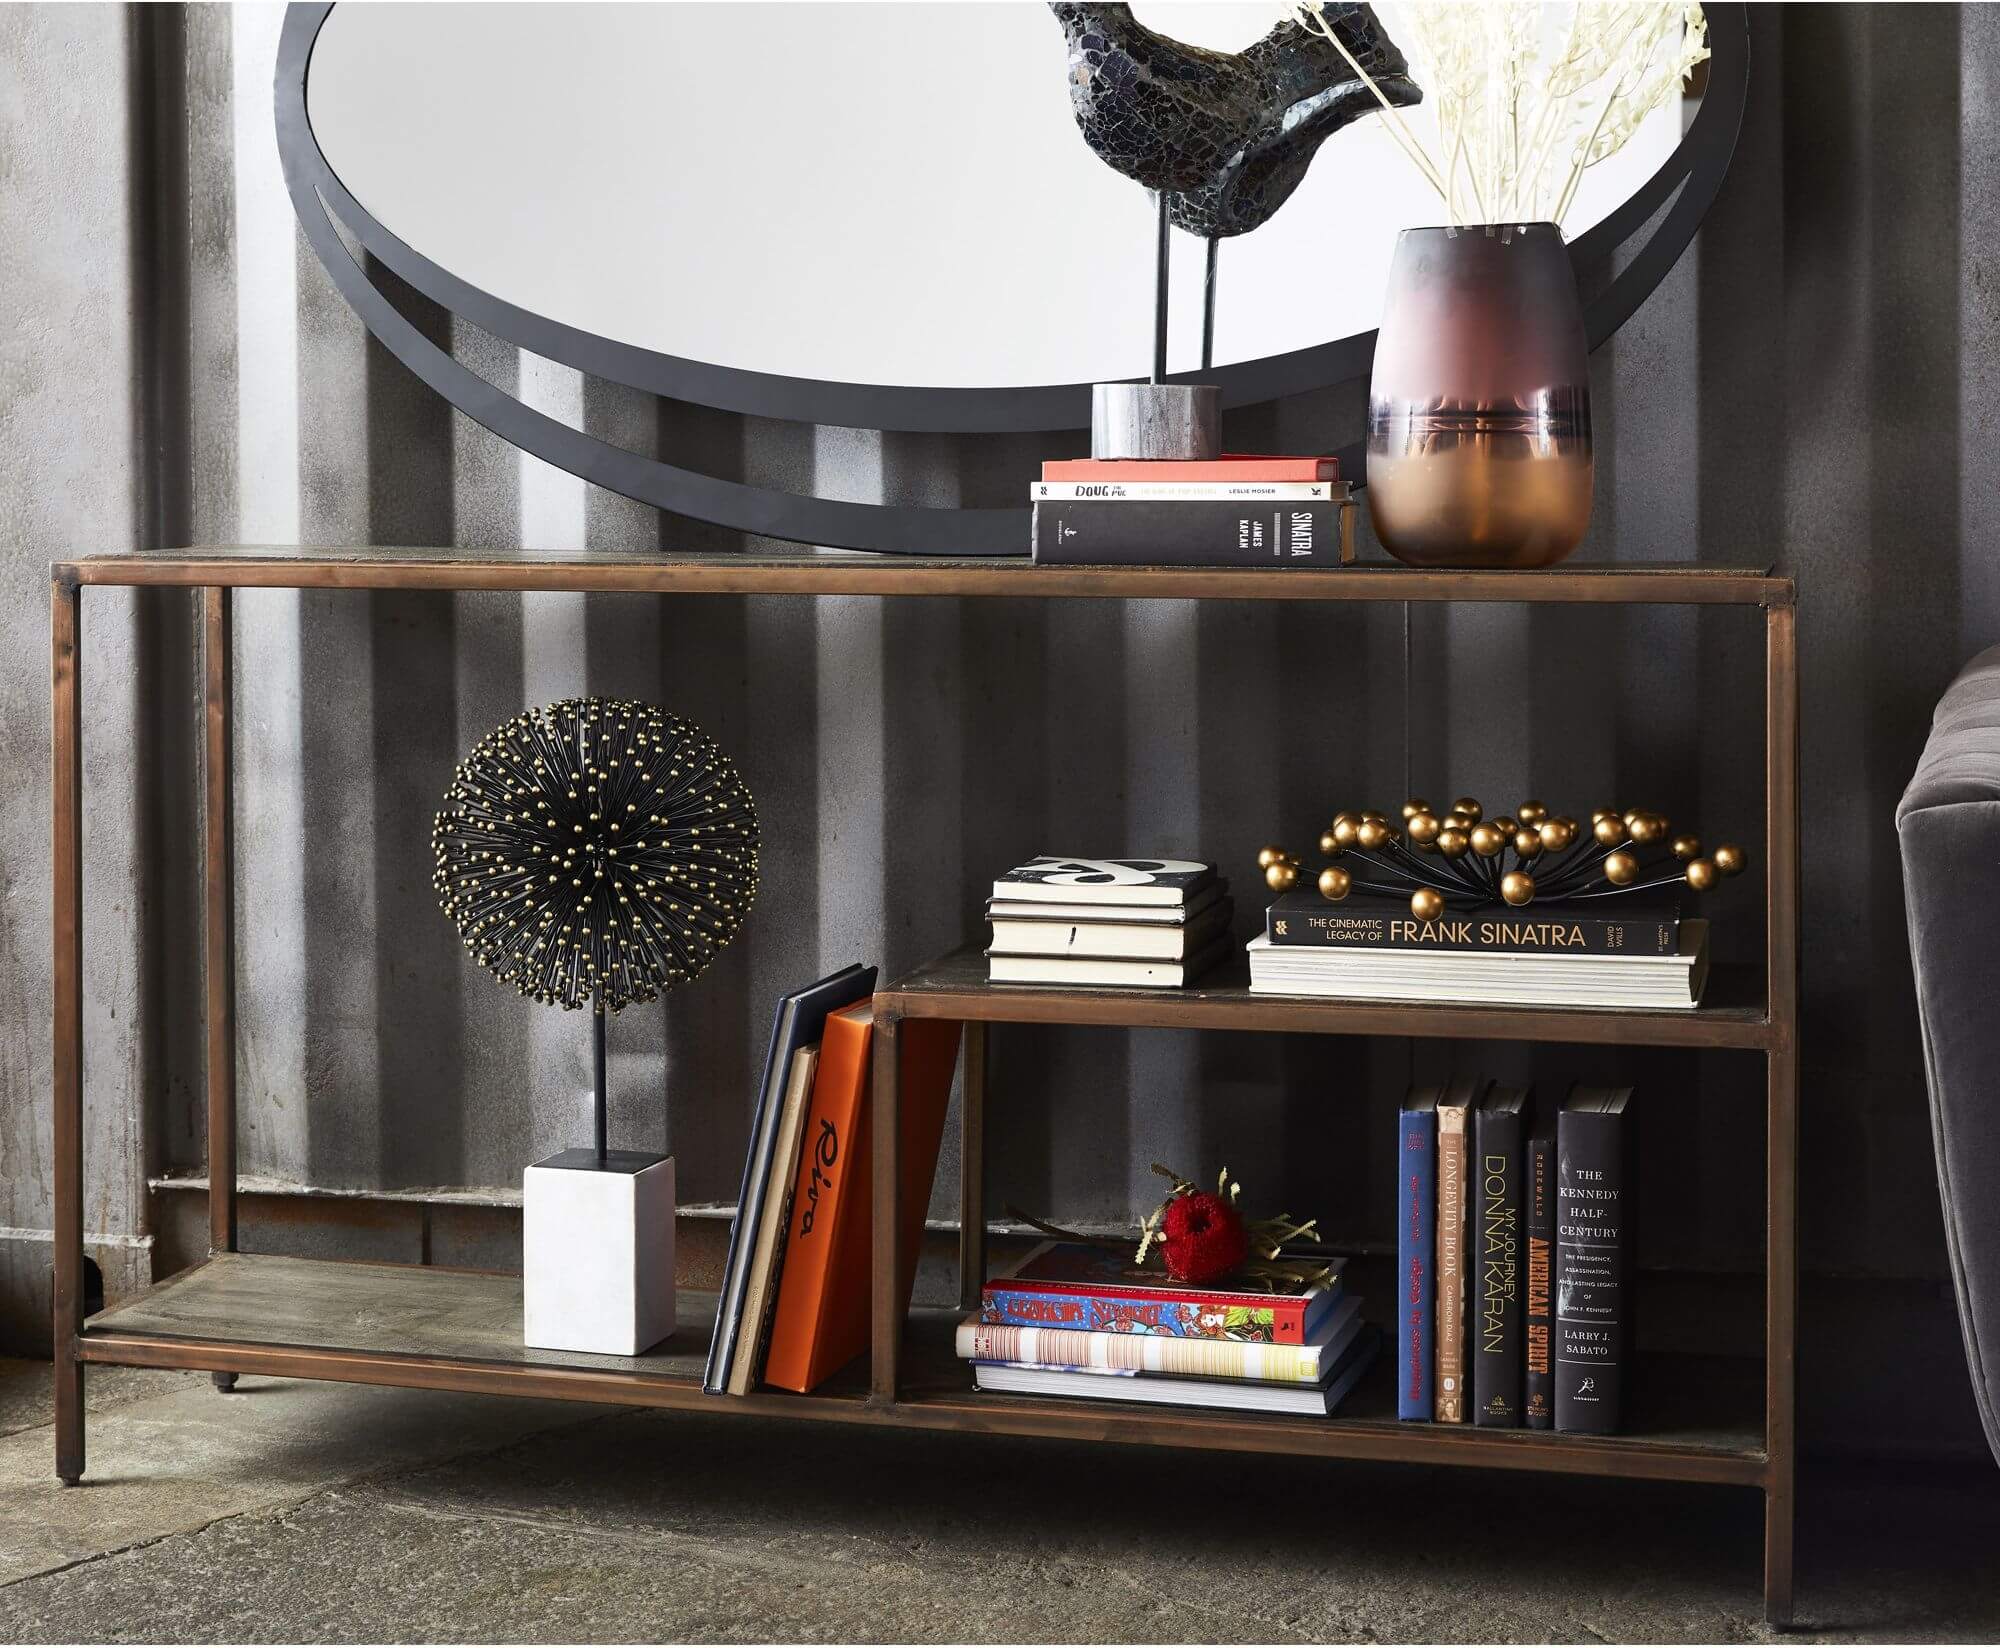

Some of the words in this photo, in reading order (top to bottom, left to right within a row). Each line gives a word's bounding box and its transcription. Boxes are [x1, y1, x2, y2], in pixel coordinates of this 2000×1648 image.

[1075, 485, 1109, 497] DOUG
[1239, 519, 1249, 549] KAPLAN
[1253, 521, 1263, 547] JAMES
[1291, 512, 1313, 556] SINATRA
[1308, 918, 1327, 928] THE
[1328, 918, 1383, 929] CINEMATIC
[1326, 930, 1366, 941] LEGACY
[1367, 931, 1383, 941] OF
[1390, 920, 1473, 944] FRANK
[1480, 922, 1587, 947] SINATRA
[1607, 926, 1615, 948] DAVID
[1615, 926, 1623, 947] WILLS
[800, 1118, 838, 1239] Riva
[1576, 1170, 1603, 1180] THE
[1445, 1151, 1457, 1233] LONGEVITY
[1560, 1187, 1619, 1200] KENNEDY
[1485, 1155, 1506, 1254] DONNA
[1570, 1207, 1608, 1218] HALF-
[1505, 1208, 1516, 1231] MY
[1560, 1225, 1619, 1238] CENTURY
[1445, 1237, 1457, 1276] BOOK
[1504, 1233, 1516, 1302] JOURNEY
[1529, 1236, 1549, 1316] AMERICAN
[1446, 1285, 1455, 1319] CAMERON
[1484, 1261, 1505, 1352] KARAN
[1446, 1321, 1455, 1342] DIAZ
[1564, 1329, 1600, 1341] LARRY
[1602, 1332, 1611, 1341] J.
[1528, 1325, 1548, 1374] SPIRIT
[1566, 1344, 1609, 1355] SABATO
